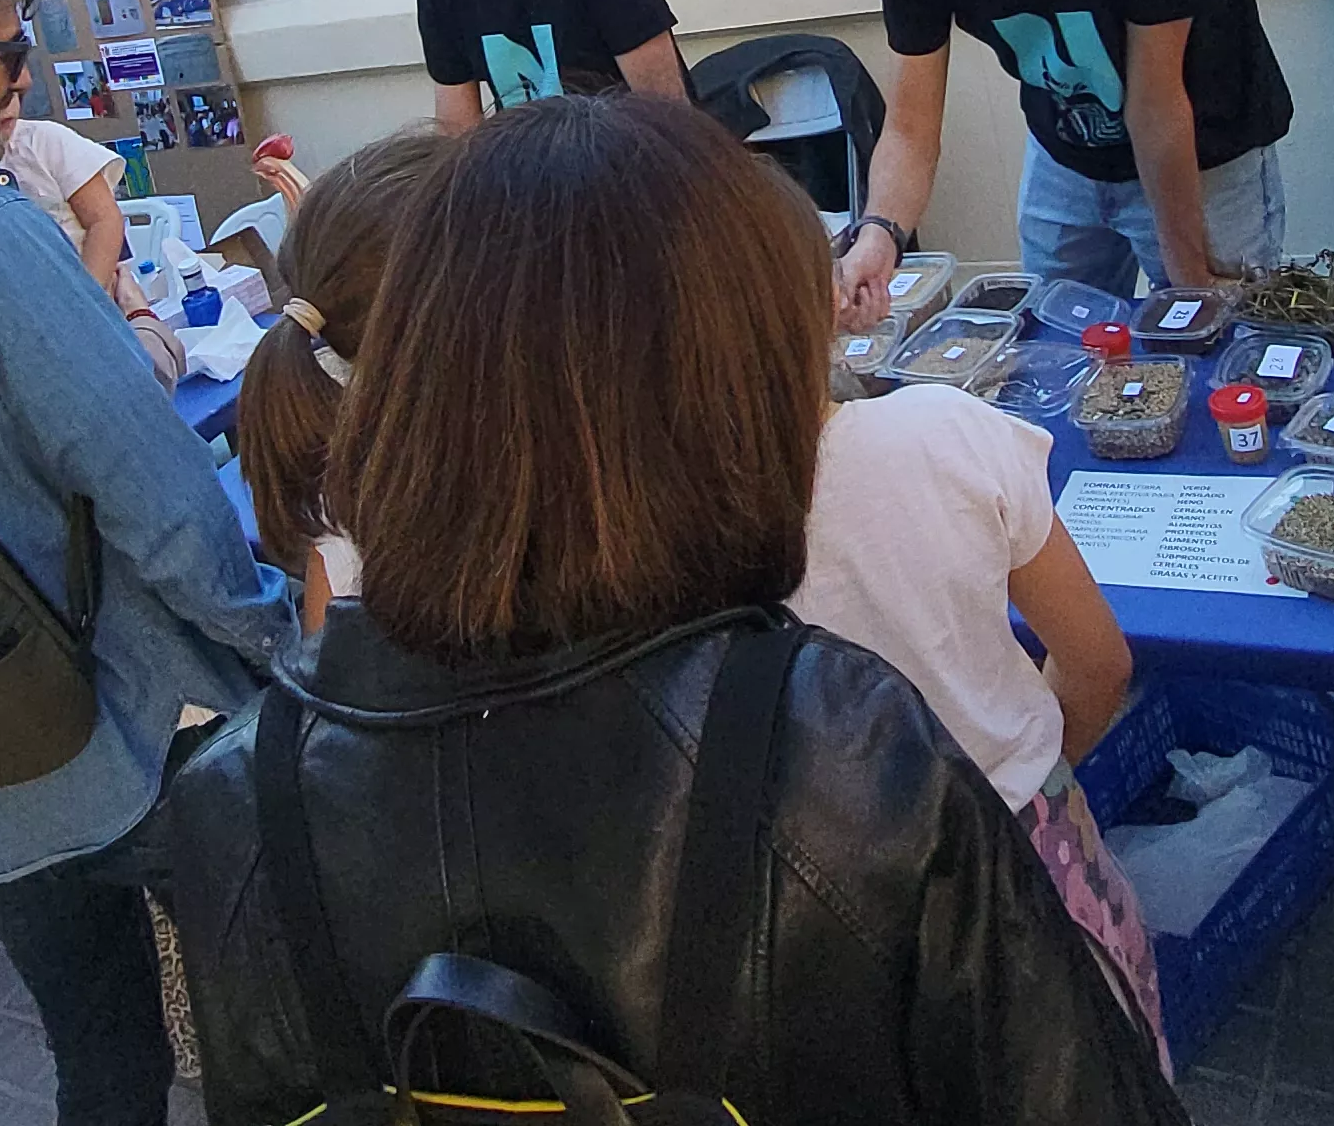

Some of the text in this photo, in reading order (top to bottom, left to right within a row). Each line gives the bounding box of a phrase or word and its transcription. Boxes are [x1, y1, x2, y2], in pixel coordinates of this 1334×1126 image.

[1238, 431, 1259, 447] 37
[1072, 504, 1156, 513] CONCENTRADOS
[1161, 536, 1218, 545] ALIMENTOS
[1159, 544, 1206, 553] FIBROSOS
[1156, 553, 1235, 564] SUBPRODUCTOS
[1152, 561, 1199, 570] CEREALES
[1149, 569, 1188, 578] GRASAS
[1199, 574, 1239, 582] ACEITES
